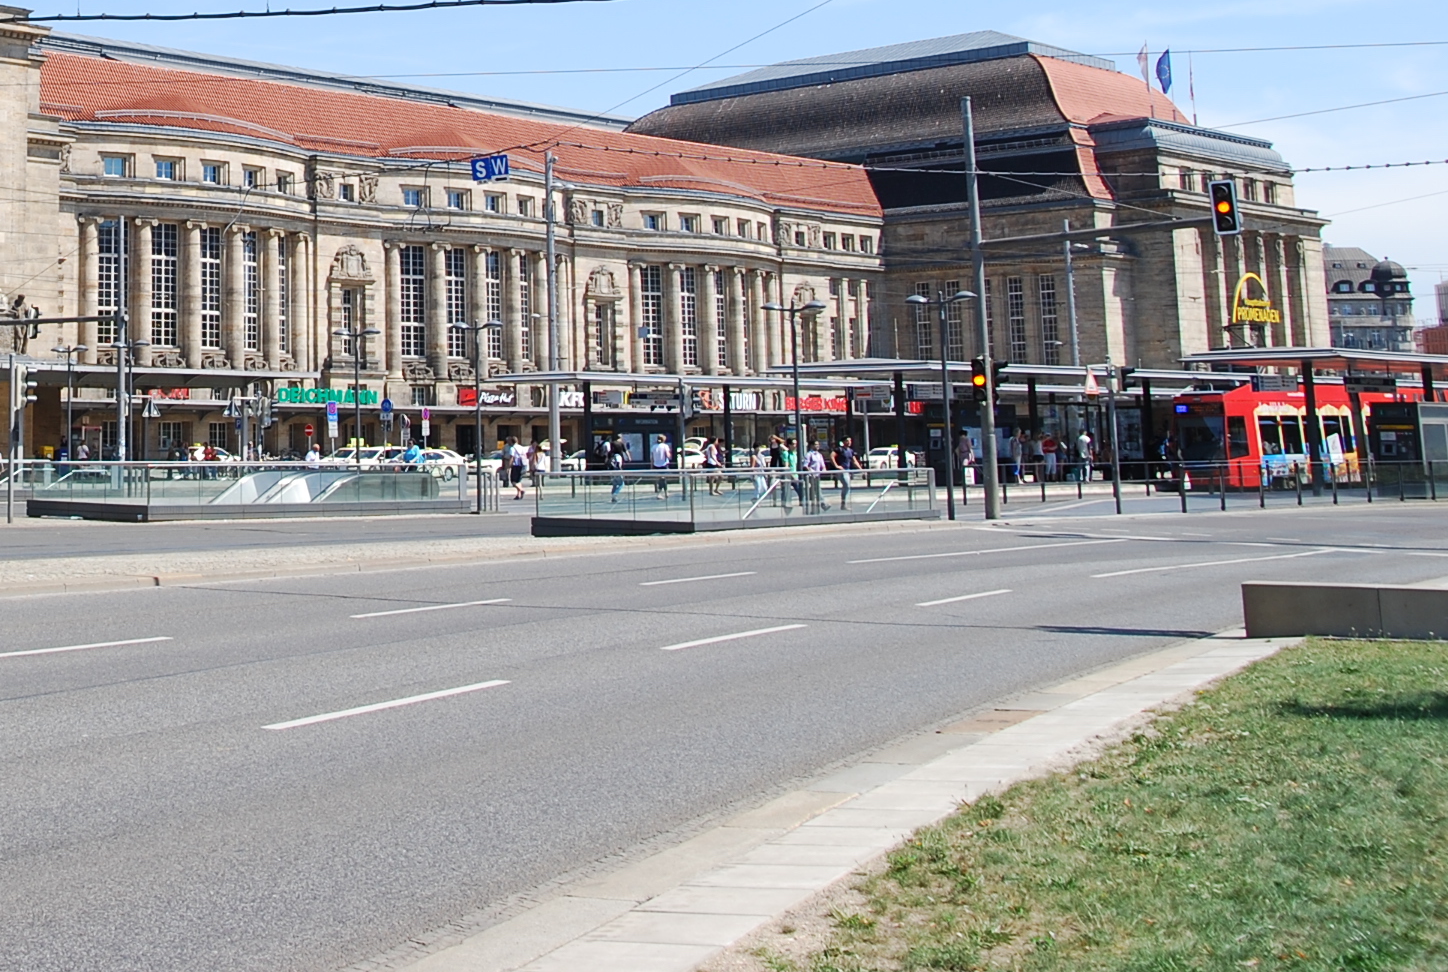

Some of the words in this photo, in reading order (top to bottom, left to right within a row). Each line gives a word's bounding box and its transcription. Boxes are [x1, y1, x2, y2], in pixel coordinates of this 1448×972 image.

[475, 161, 487, 178] S
[491, 158, 506, 175] W
[278, 387, 378, 404] DEICHMANN
[479, 391, 499, 404] Pizza
[499, 391, 514, 404] Hut
[718, 392, 757, 410] STURN
